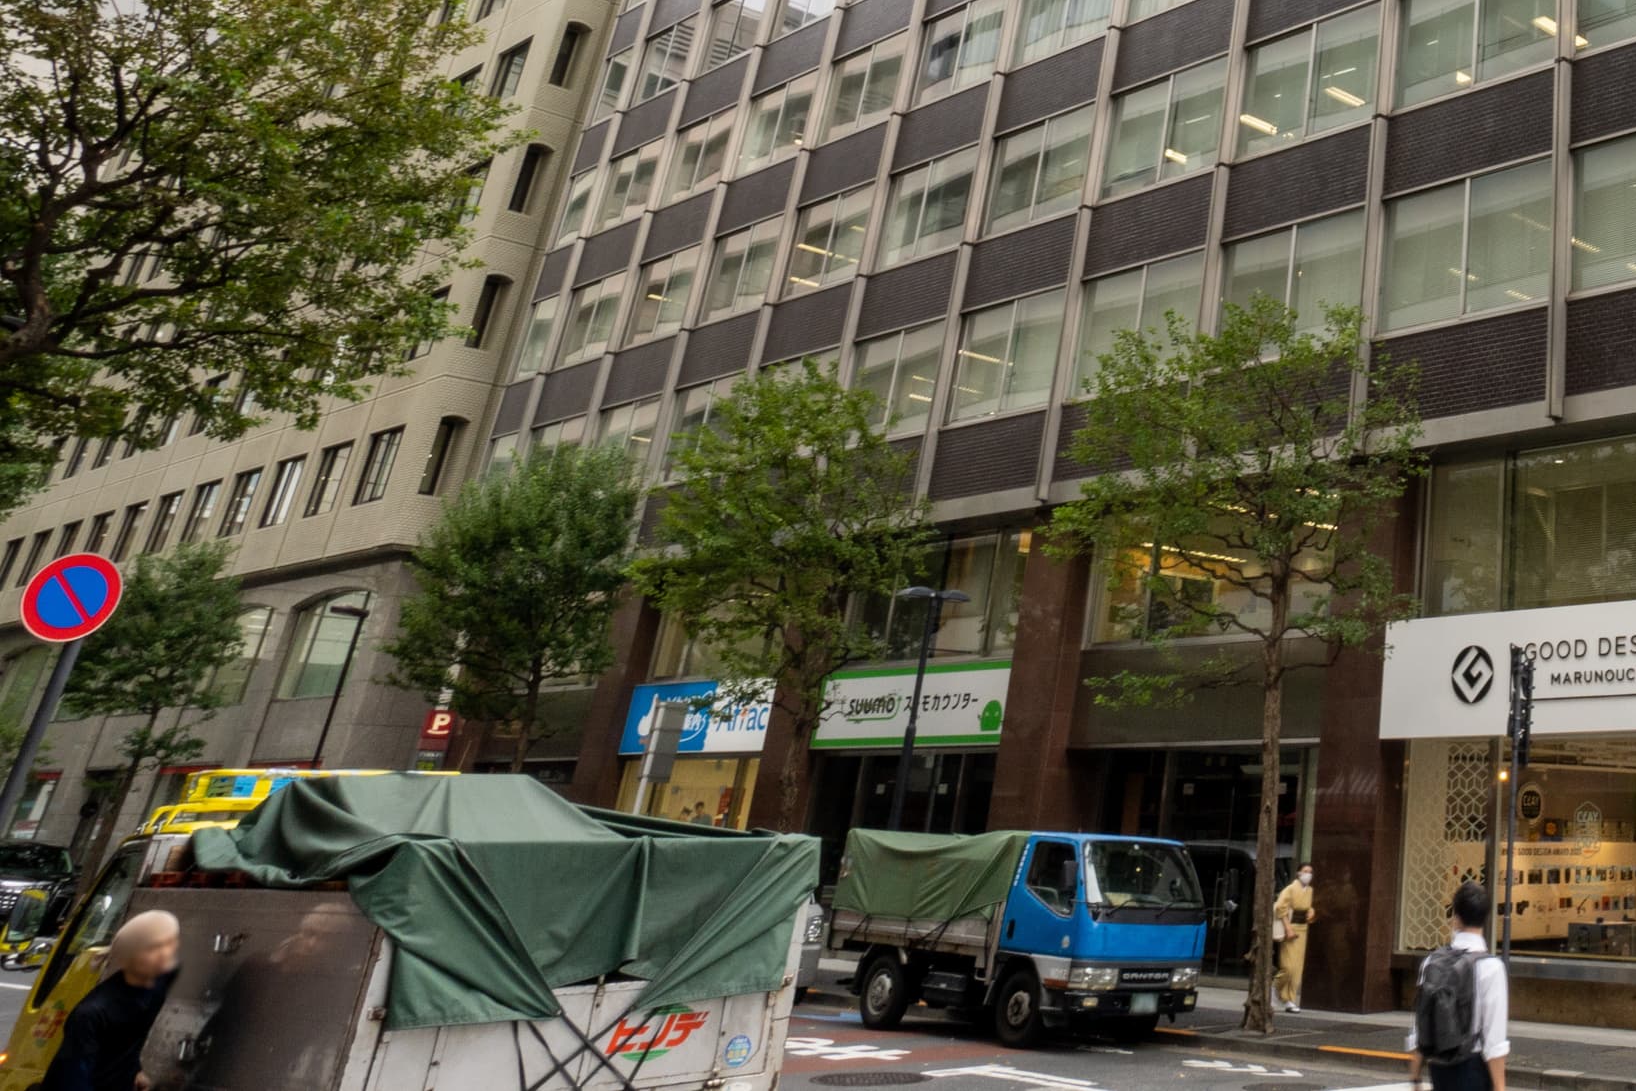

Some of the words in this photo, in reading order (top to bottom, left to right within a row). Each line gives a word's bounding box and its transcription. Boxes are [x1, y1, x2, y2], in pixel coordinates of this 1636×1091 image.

[1524, 639, 1588, 662] GOOD
[904, 692, 979, 713] スモカウンター
[432, 713, 452, 732] P
[605, 1011, 710, 1055] ヒノデ
